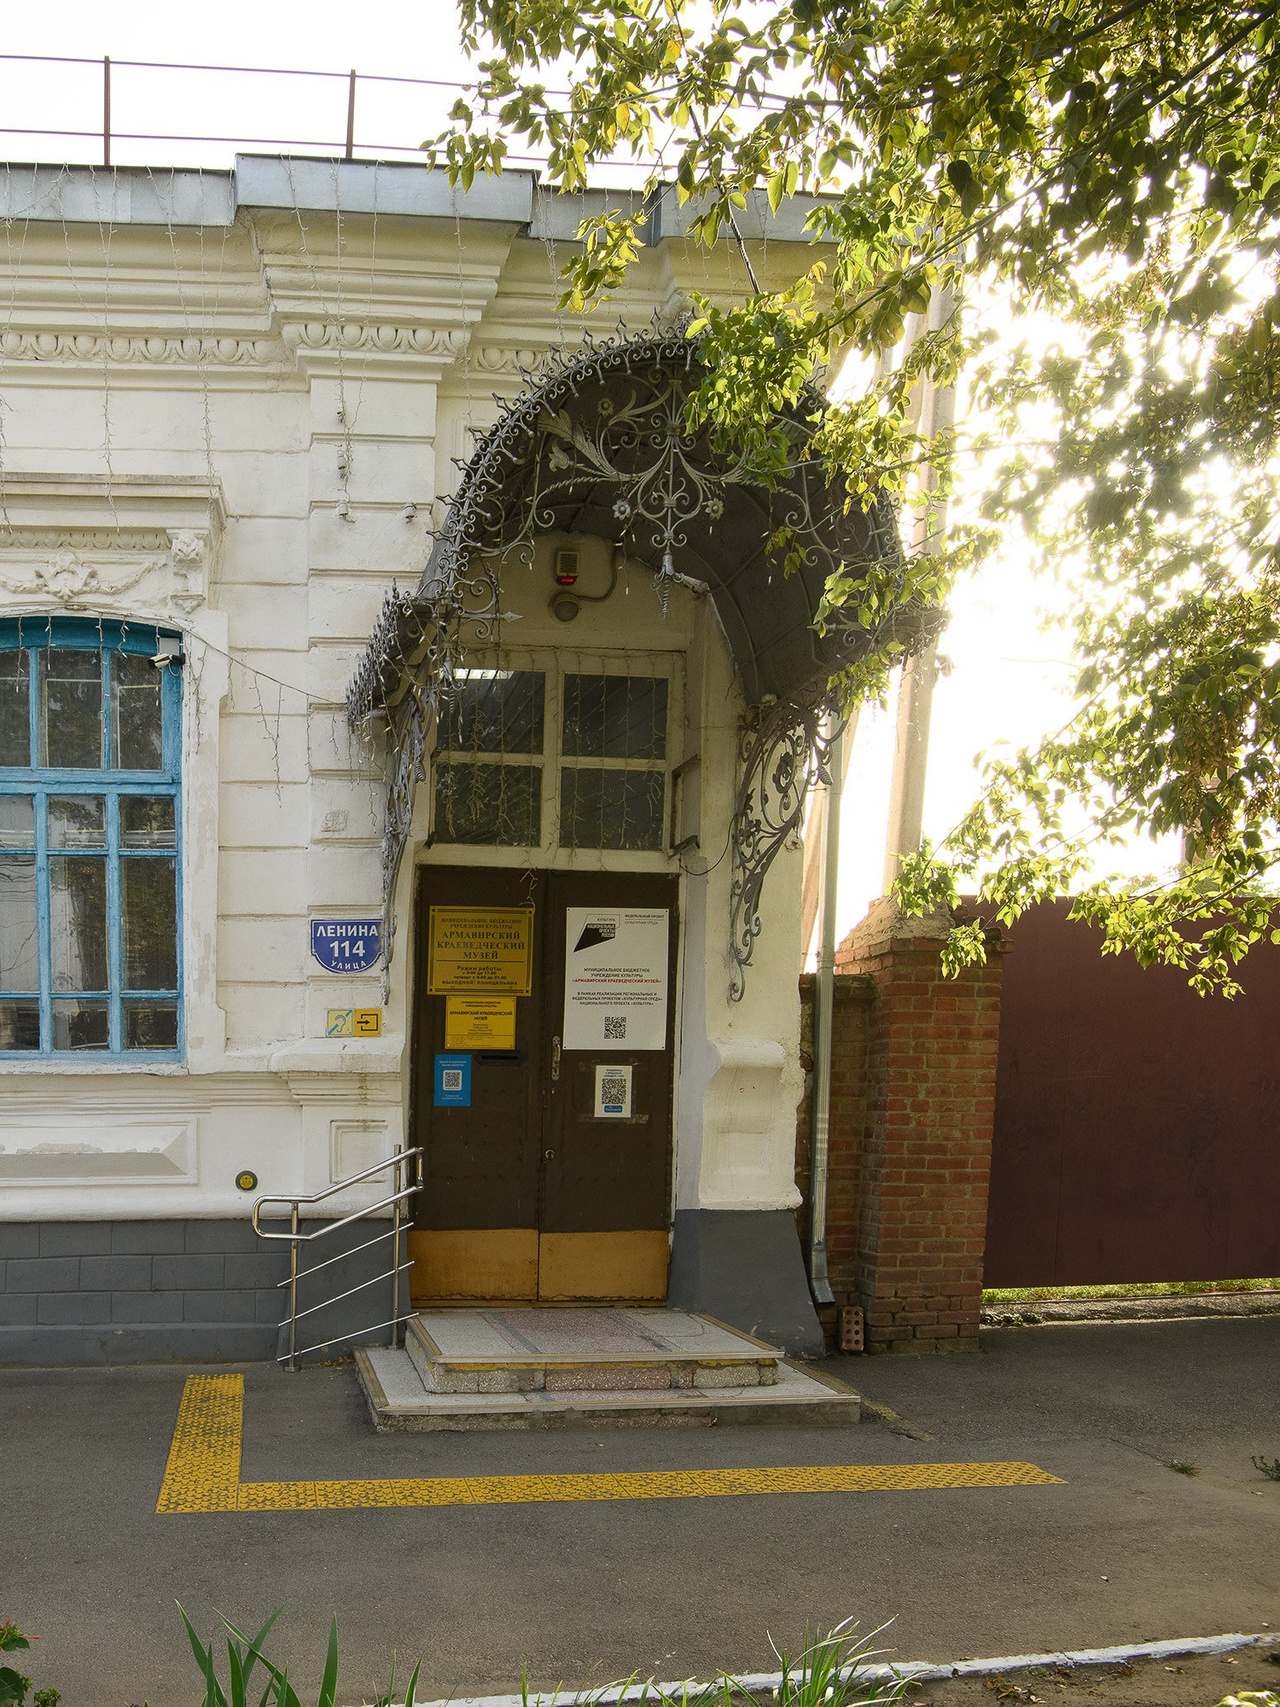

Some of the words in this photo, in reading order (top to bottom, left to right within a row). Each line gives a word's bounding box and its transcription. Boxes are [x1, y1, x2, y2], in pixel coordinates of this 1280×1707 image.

[316, 925, 379, 937] ЛЕНИНА
[442, 931, 520, 940] АРМАВИРСКИЙ
[329, 940, 366, 958] 114
[437, 941, 525, 950] КРАЕВЕДЧЕСКИЙ
[463, 951, 499, 960] МУЗЕЙ
[330, 960, 367, 970] УЛИЦА
